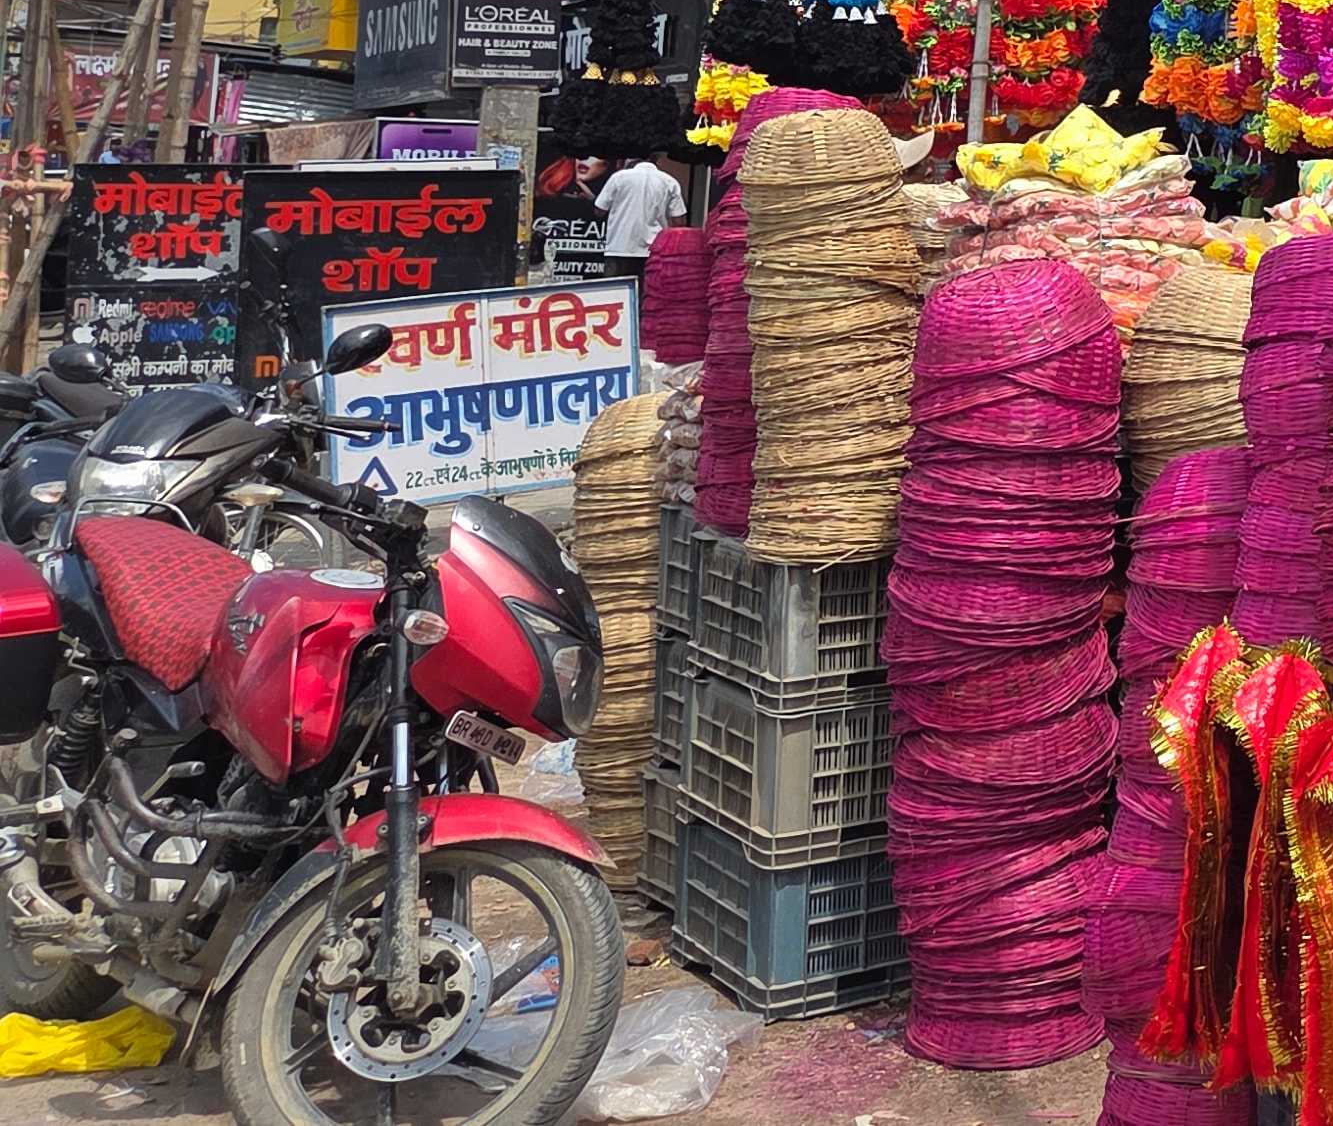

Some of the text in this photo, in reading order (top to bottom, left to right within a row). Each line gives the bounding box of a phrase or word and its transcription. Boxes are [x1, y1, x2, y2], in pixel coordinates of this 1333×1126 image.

[458, 37, 558, 50] HAIR & BEAUTY ZONE
[265, 184, 492, 238] मोबाईल
[130, 223, 224, 260] शॉप
[322, 247, 438, 293] शॉप
[99, 297, 134, 318] Redmi
[140, 297, 195, 318] realme
[100, 328, 142, 348] Apple
[360, 293, 624, 373] वर्ण मंदिर
[191, 359, 210, 375] का
[452, 717, 472, 738] BR
